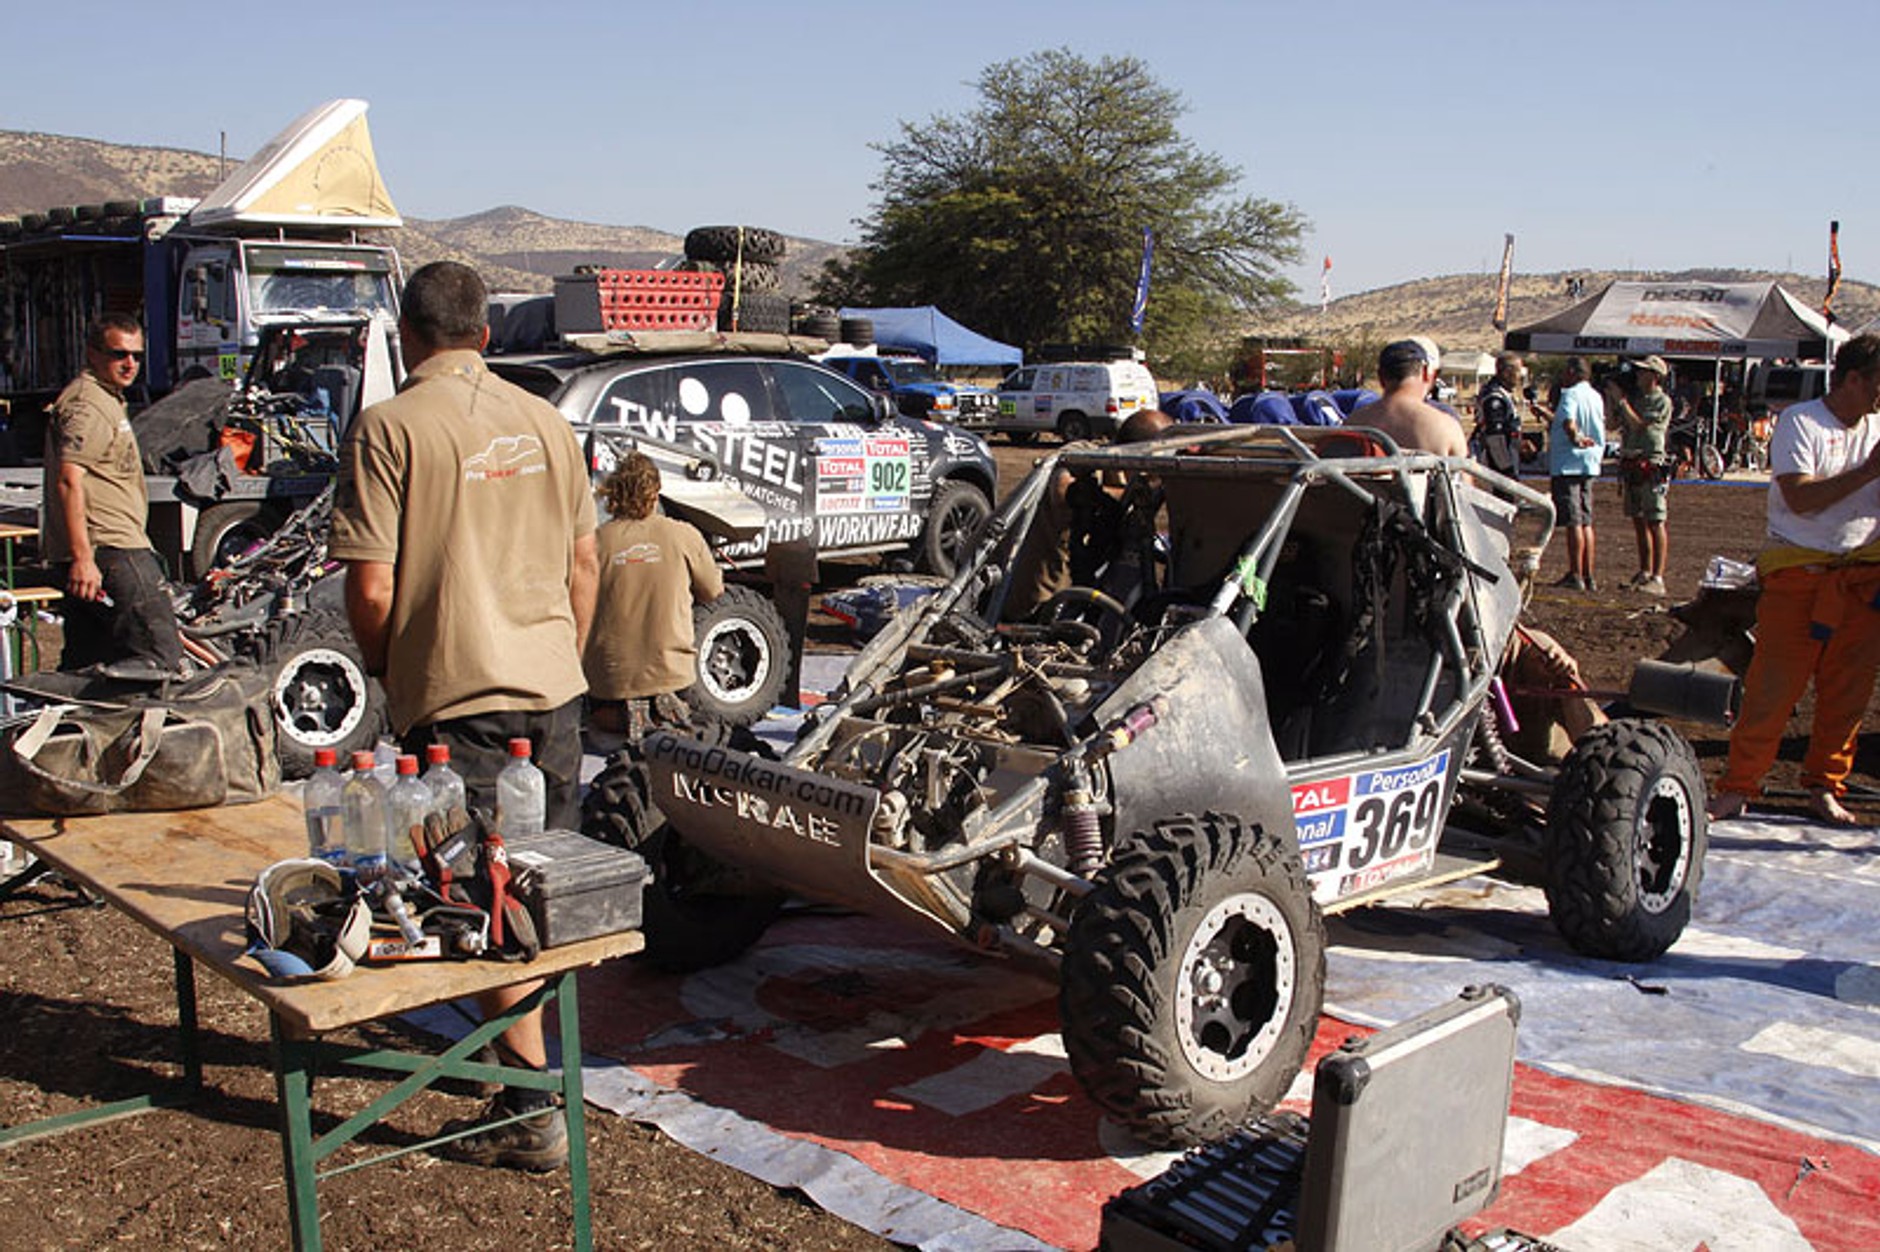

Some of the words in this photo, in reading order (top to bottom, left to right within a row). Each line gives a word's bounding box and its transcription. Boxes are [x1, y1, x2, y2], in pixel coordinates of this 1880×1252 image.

[1641, 288, 1730, 303] DESERT
[1573, 336, 1628, 350] DESERT
[610, 396, 678, 444] TW
[692, 422, 804, 494] STEEL
[866, 441, 908, 455] TOTAL
[820, 459, 864, 474] TOTAL
[872, 461, 906, 491] 902
[743, 483, 798, 513] WATCHES
[818, 513, 921, 547] WORKWEAR
[656, 736, 865, 816] ProDakar.com
[1347, 779, 1441, 870] 369
